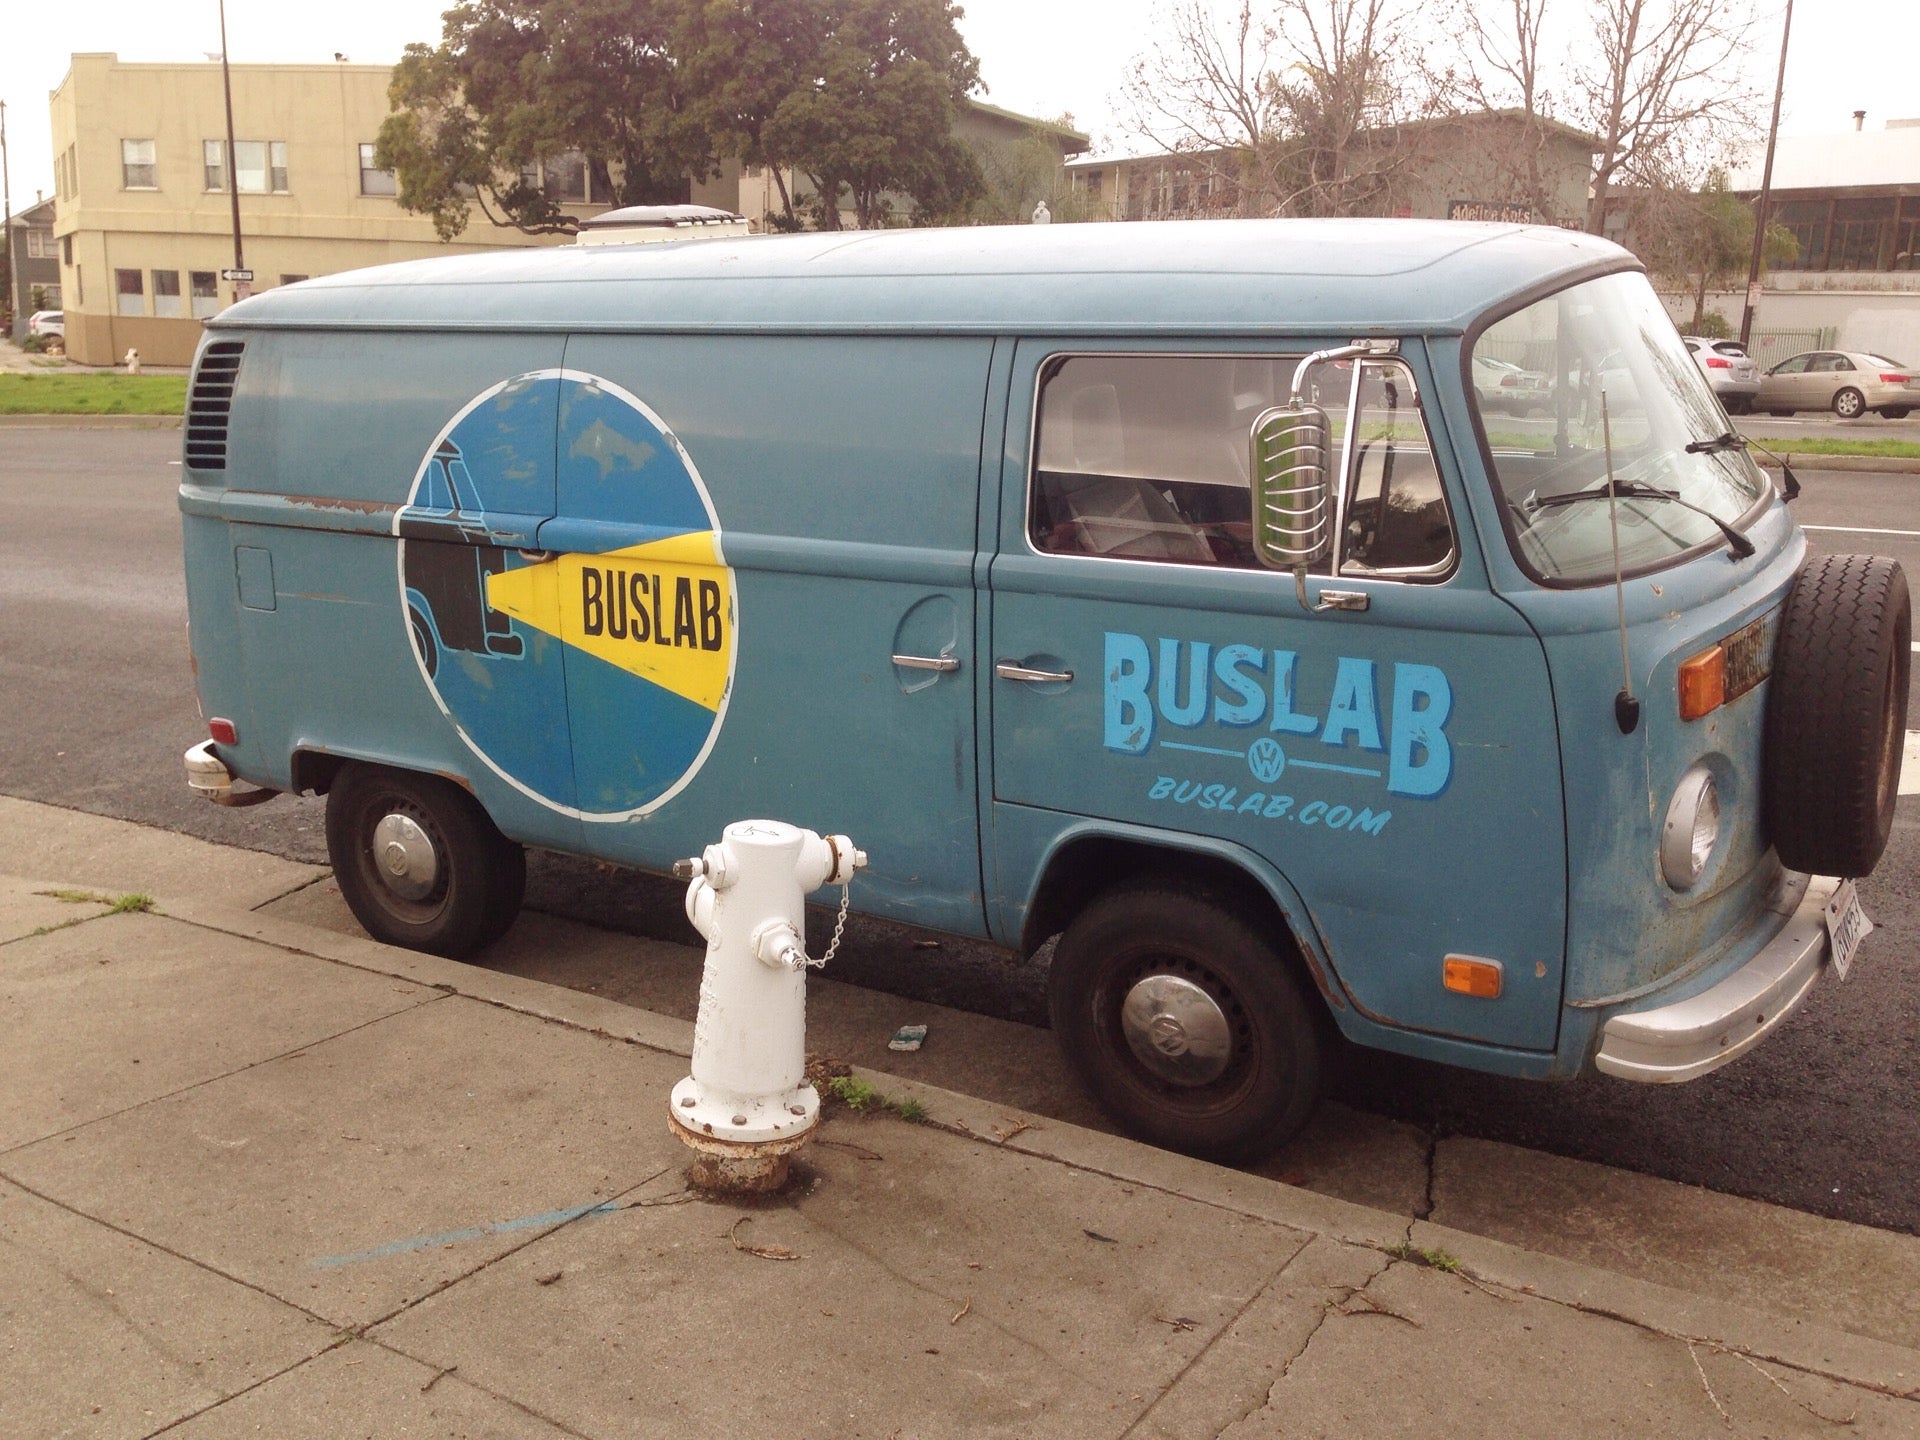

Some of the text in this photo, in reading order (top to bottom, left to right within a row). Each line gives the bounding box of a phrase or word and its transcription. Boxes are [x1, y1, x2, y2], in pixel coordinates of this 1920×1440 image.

[582, 566, 722, 652] BUSLAB
[1103, 632, 1453, 798] BUSLAB
[1148, 776, 1392, 836] BUSLAB.COM
